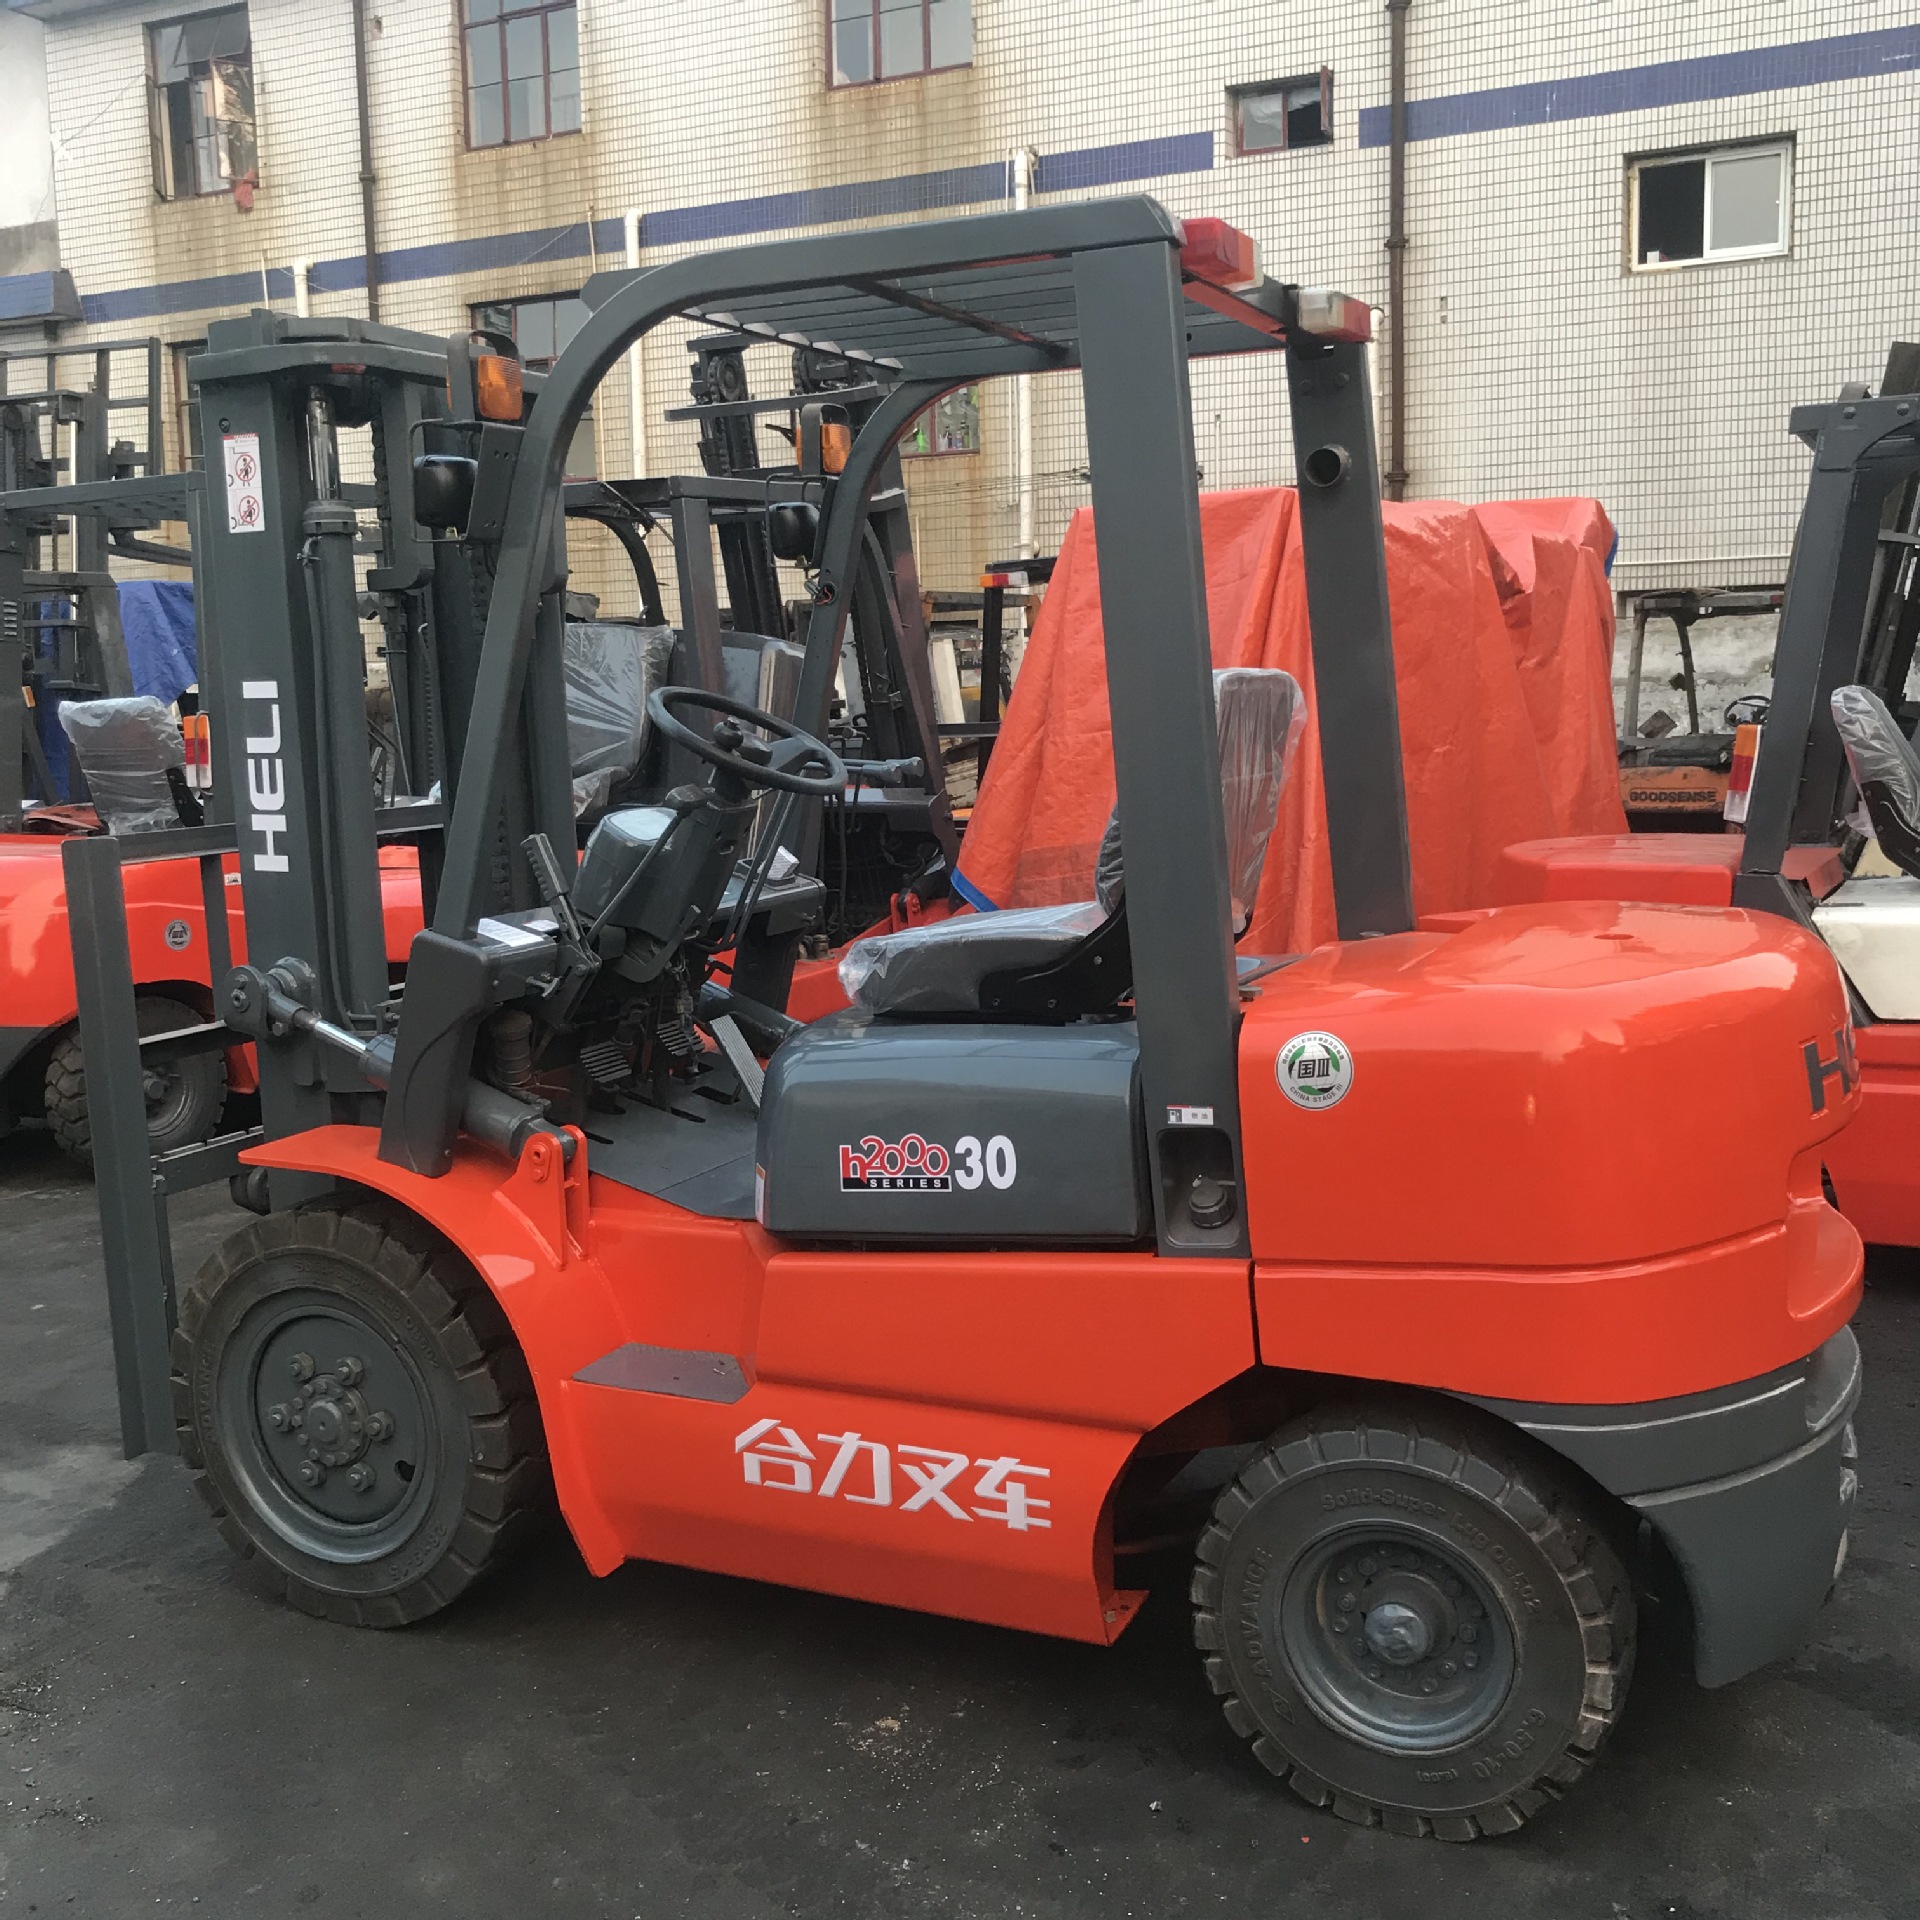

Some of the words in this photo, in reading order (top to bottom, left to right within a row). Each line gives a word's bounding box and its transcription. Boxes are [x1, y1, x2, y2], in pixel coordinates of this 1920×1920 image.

[243, 681, 289, 872] HELI
[1630, 791, 1716, 802] GOODSENSE
[1290, 1087, 1310, 1102] CHINA
[1313, 1091, 1337, 1103] STAGE
[870, 1179, 941, 1188] SERIES
[955, 1135, 1017, 1190] 30
[735, 1418, 1051, 1531] 合力叉车
[1241, 1547, 1272, 1677] ADVANCE
